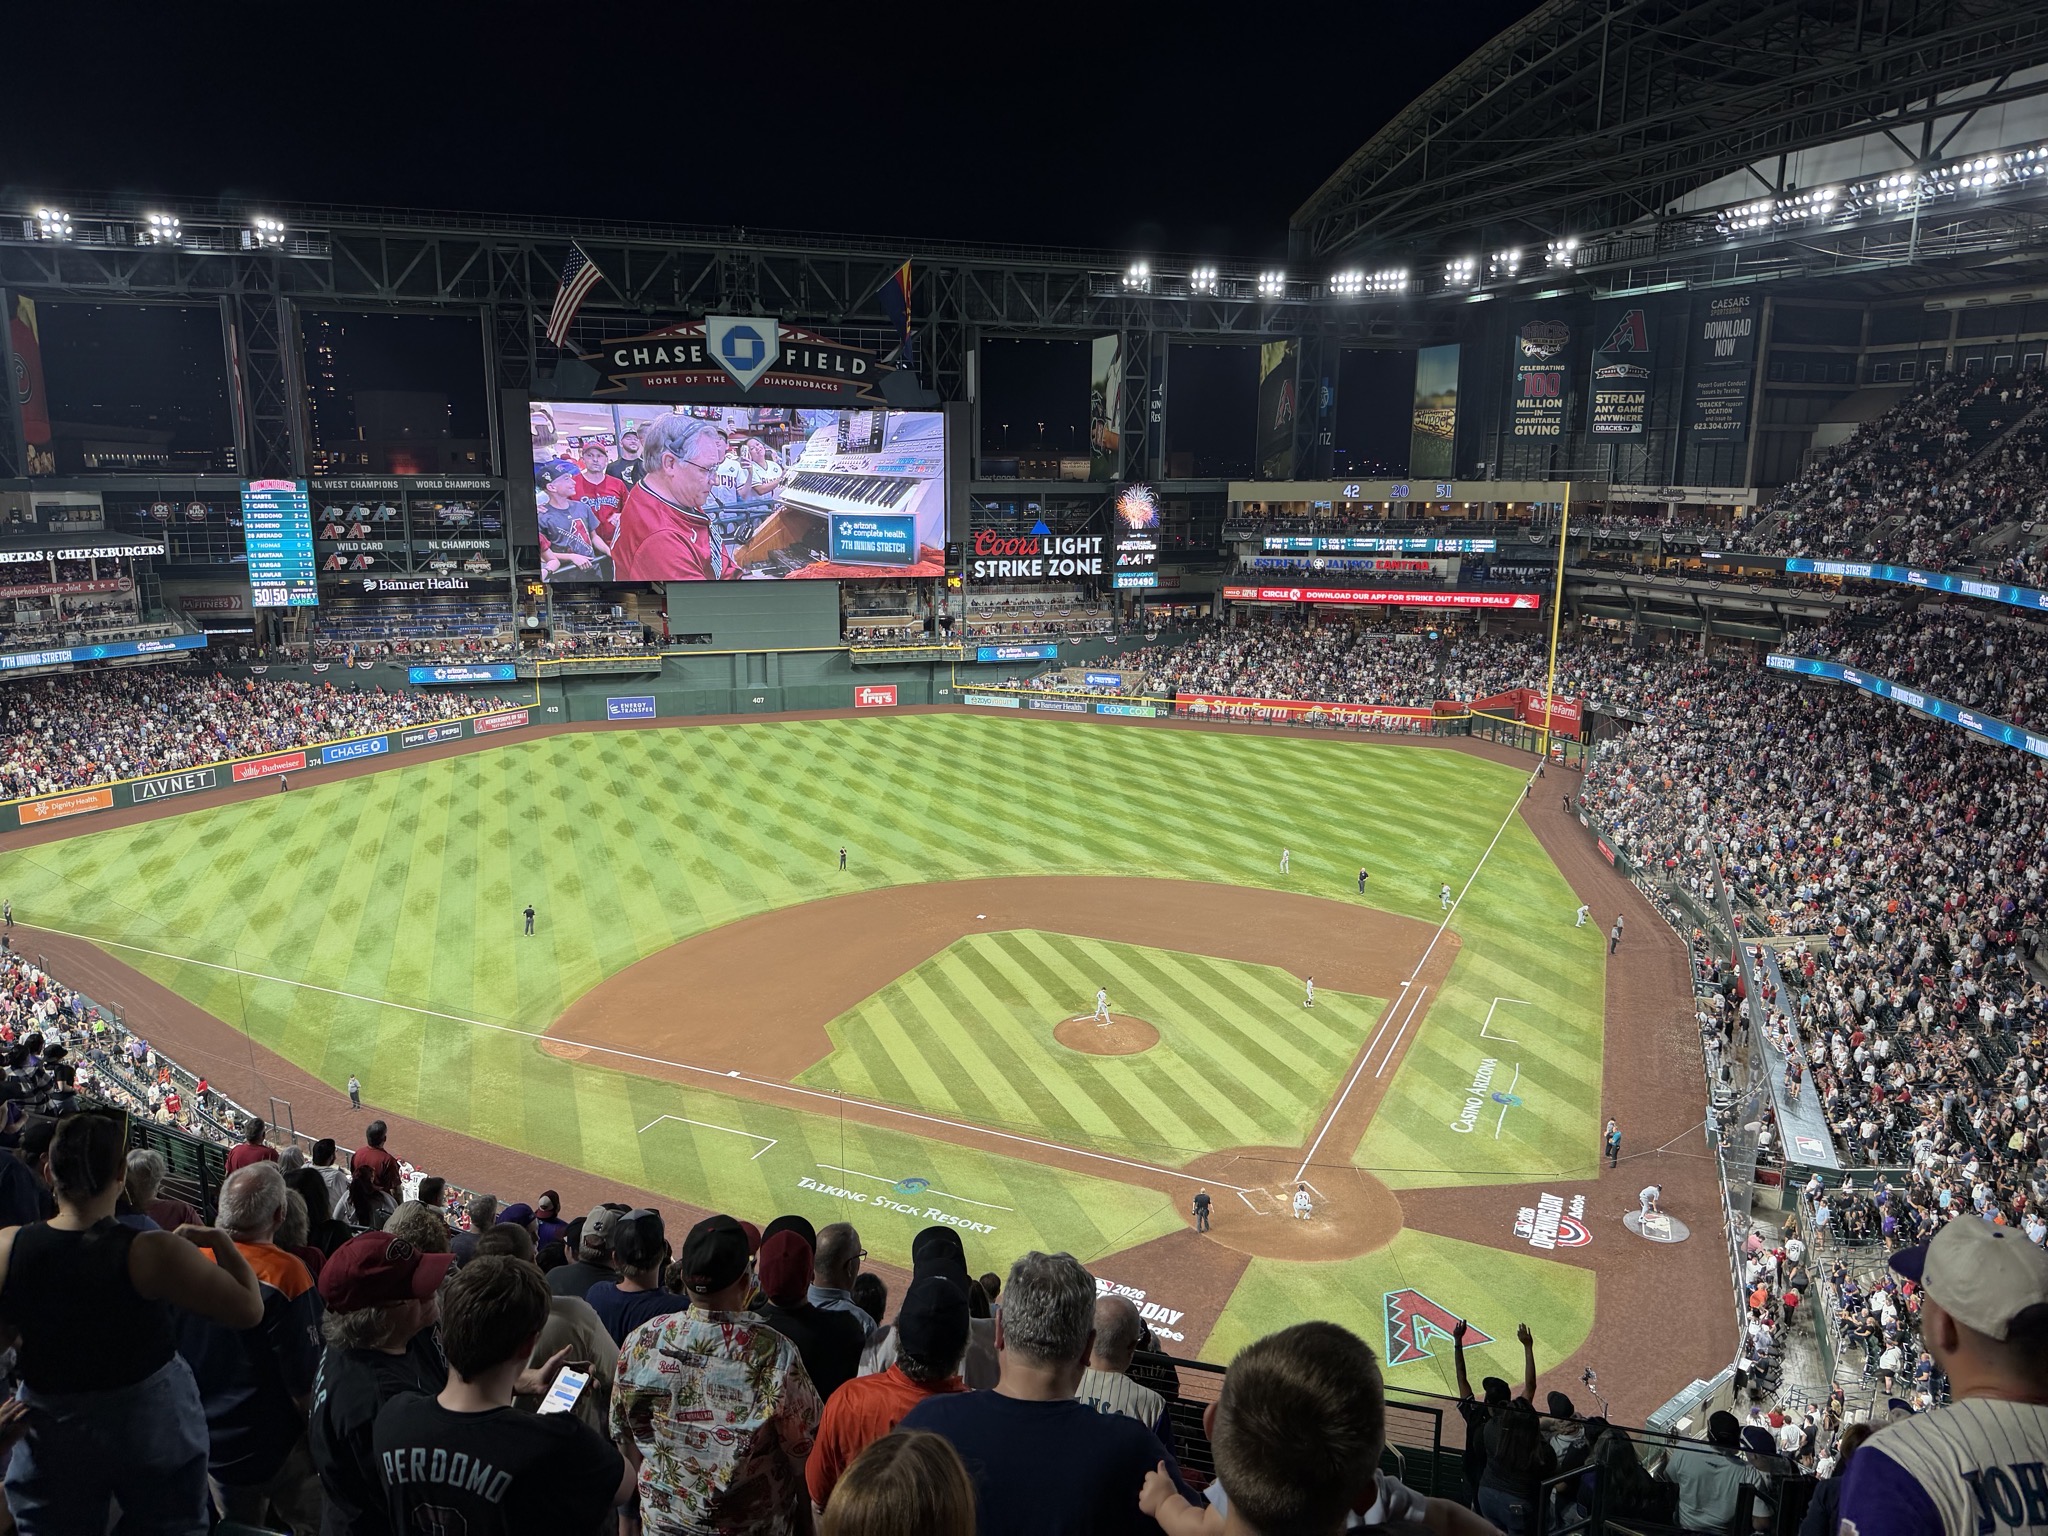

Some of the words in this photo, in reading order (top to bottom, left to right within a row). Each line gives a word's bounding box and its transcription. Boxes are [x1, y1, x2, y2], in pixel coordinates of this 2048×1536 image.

[1711, 296, 1750, 309] CAESARS
[1704, 318, 1751, 339] DOWNLOAD
[1715, 338, 1736, 357] NOW
[614, 345, 702, 367] CHASE
[787, 349, 867, 375] FIELD
[648, 376, 678, 386] HOME
[685, 376, 698, 384] OF
[706, 375, 725, 383] THE
[764, 377, 838, 391] DIAMONDBACKS
[1516, 399, 1562, 408] MILLION
[1595, 394, 1645, 404] STREAM
[1514, 426, 1560, 435] GIVING
[1693, 422, 1742, 430] 623.304.0777
[1343, 485, 1360, 498] 42
[1390, 485, 1410, 497] 20
[1436, 485, 1452, 498] 51
[854, 530, 883, 538] complete
[841, 540, 852, 549] 7TH
[854, 541, 876, 551] INNING
[877, 542, 905, 553] STRETCH
[974, 529, 1040, 556] Coors
[1044, 538, 1102, 554] LIGHT
[0, 551, 43, 563] BEERS
[47, 551, 54, 561] &
[56, 545, 165, 560] CHEESEBURGERS
[974, 560, 1042, 577] STRIKE
[1048, 559, 1102, 576] ZONE
[1814, 562, 1825, 572] 7TH
[1825, 563, 1845, 574] INNING
[1846, 565, 1871, 576] STRETCH
[1118, 578, 1154, 587] $320490
[40, 585, 63, 594] Burger
[195, 600, 229, 608] FITNESS
[1353, 592, 1369, 600] OUR
[1406, 594, 1433, 602] STRIKE
[1483, 596, 1509, 604] DEALS
[1, 657, 15, 668] 7TH
[16, 655, 41, 666] INNING
[42, 651, 72, 663] STRETCH
[1771, 657, 1794, 669] STRETCH
[860, 688, 892, 704] fry's
[1063, 703, 1083, 711] Health
[405, 734, 424, 743] PEPSI
[442, 727, 460, 737] PEPSI
[330, 740, 368, 759] CHASE
[262, 760, 299, 773] Budweiser
[309, 758, 321, 766] 374
[143, 772, 206, 798] AVNET
[52, 801, 75, 810] Dignity
[76, 796, 97, 804] Health
[1112, 1284, 1146, 1300] 2026
[1140, 1302, 1184, 1325] DAY
[658, 1360, 681, 1373] Reds
[382, 1447, 513, 1504] PERDOMO
